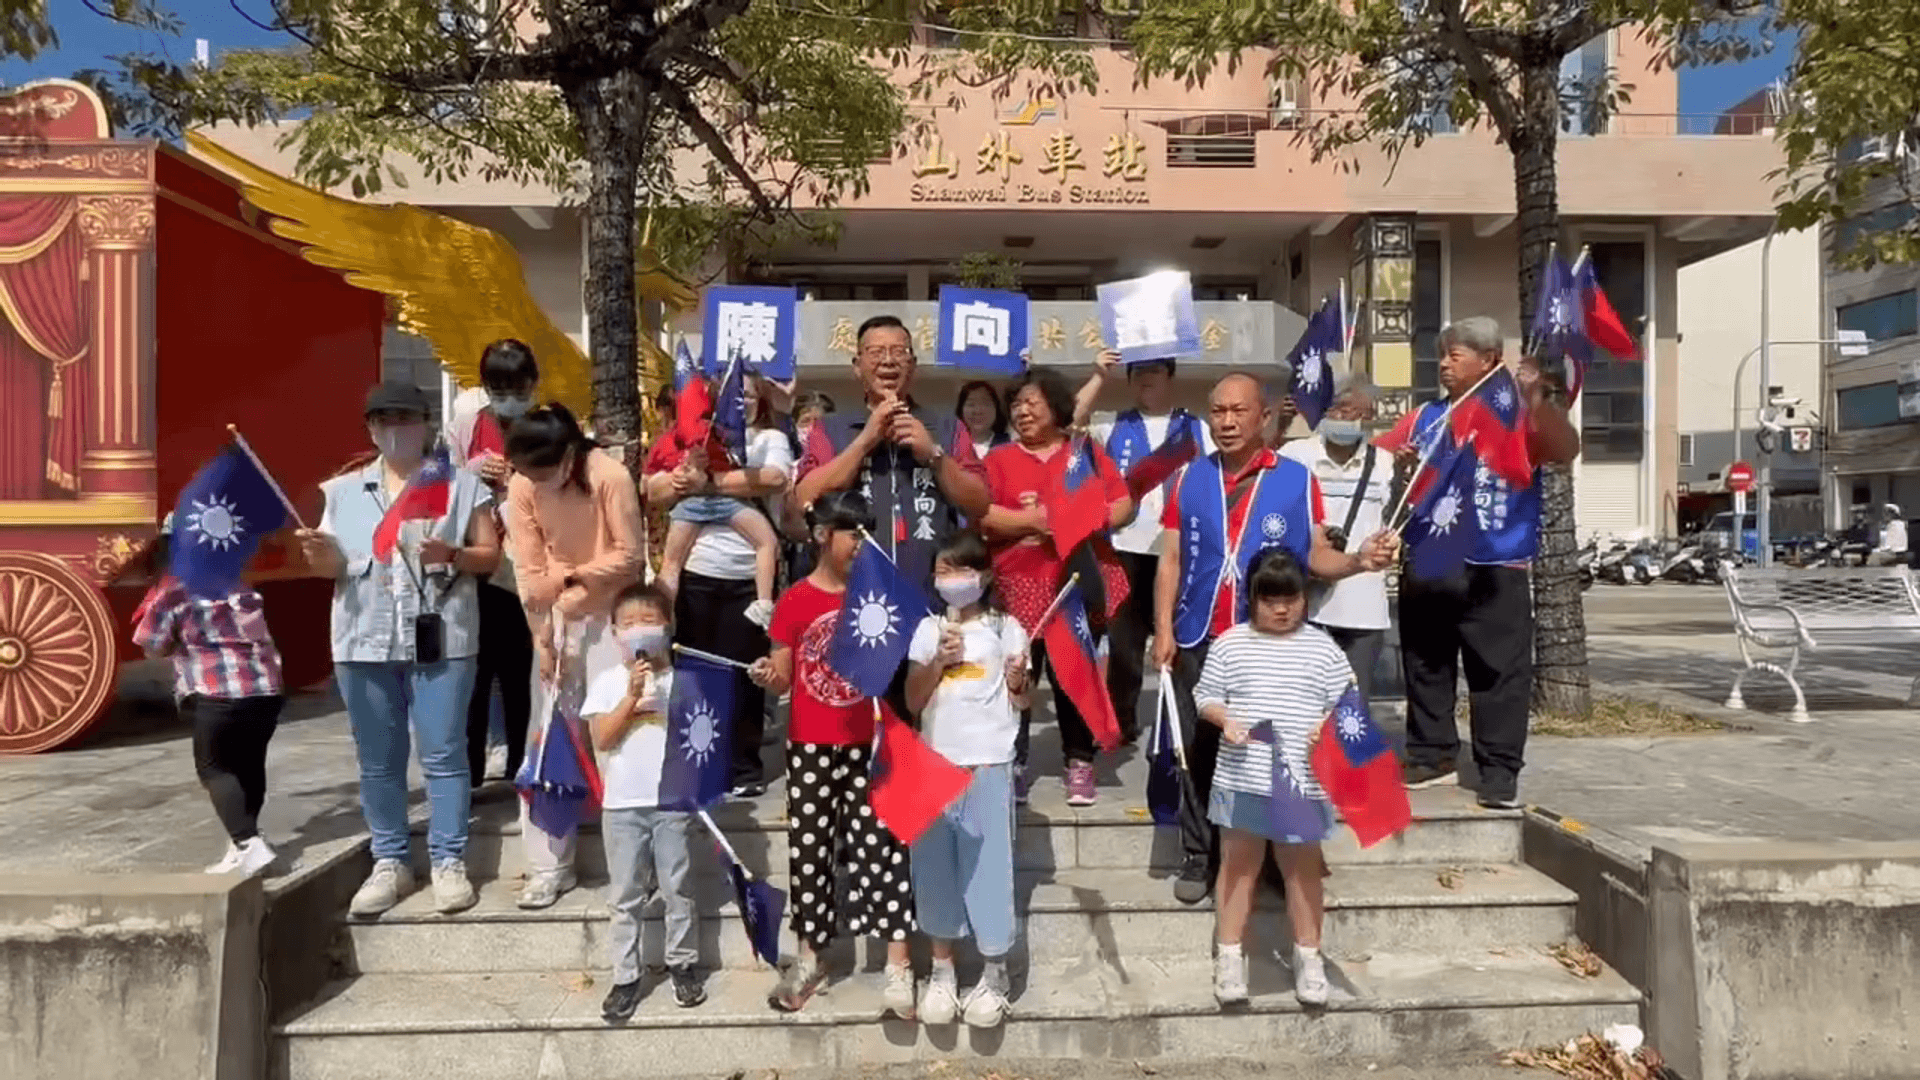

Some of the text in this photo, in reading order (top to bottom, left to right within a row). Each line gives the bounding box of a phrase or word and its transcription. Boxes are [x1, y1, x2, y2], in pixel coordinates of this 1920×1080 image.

[911, 129, 1148, 184] 山外車站
[910, 183, 1150, 202] Shanwai Bus Station
[716, 301, 778, 363] 陳
[952, 300, 1011, 357] 向
